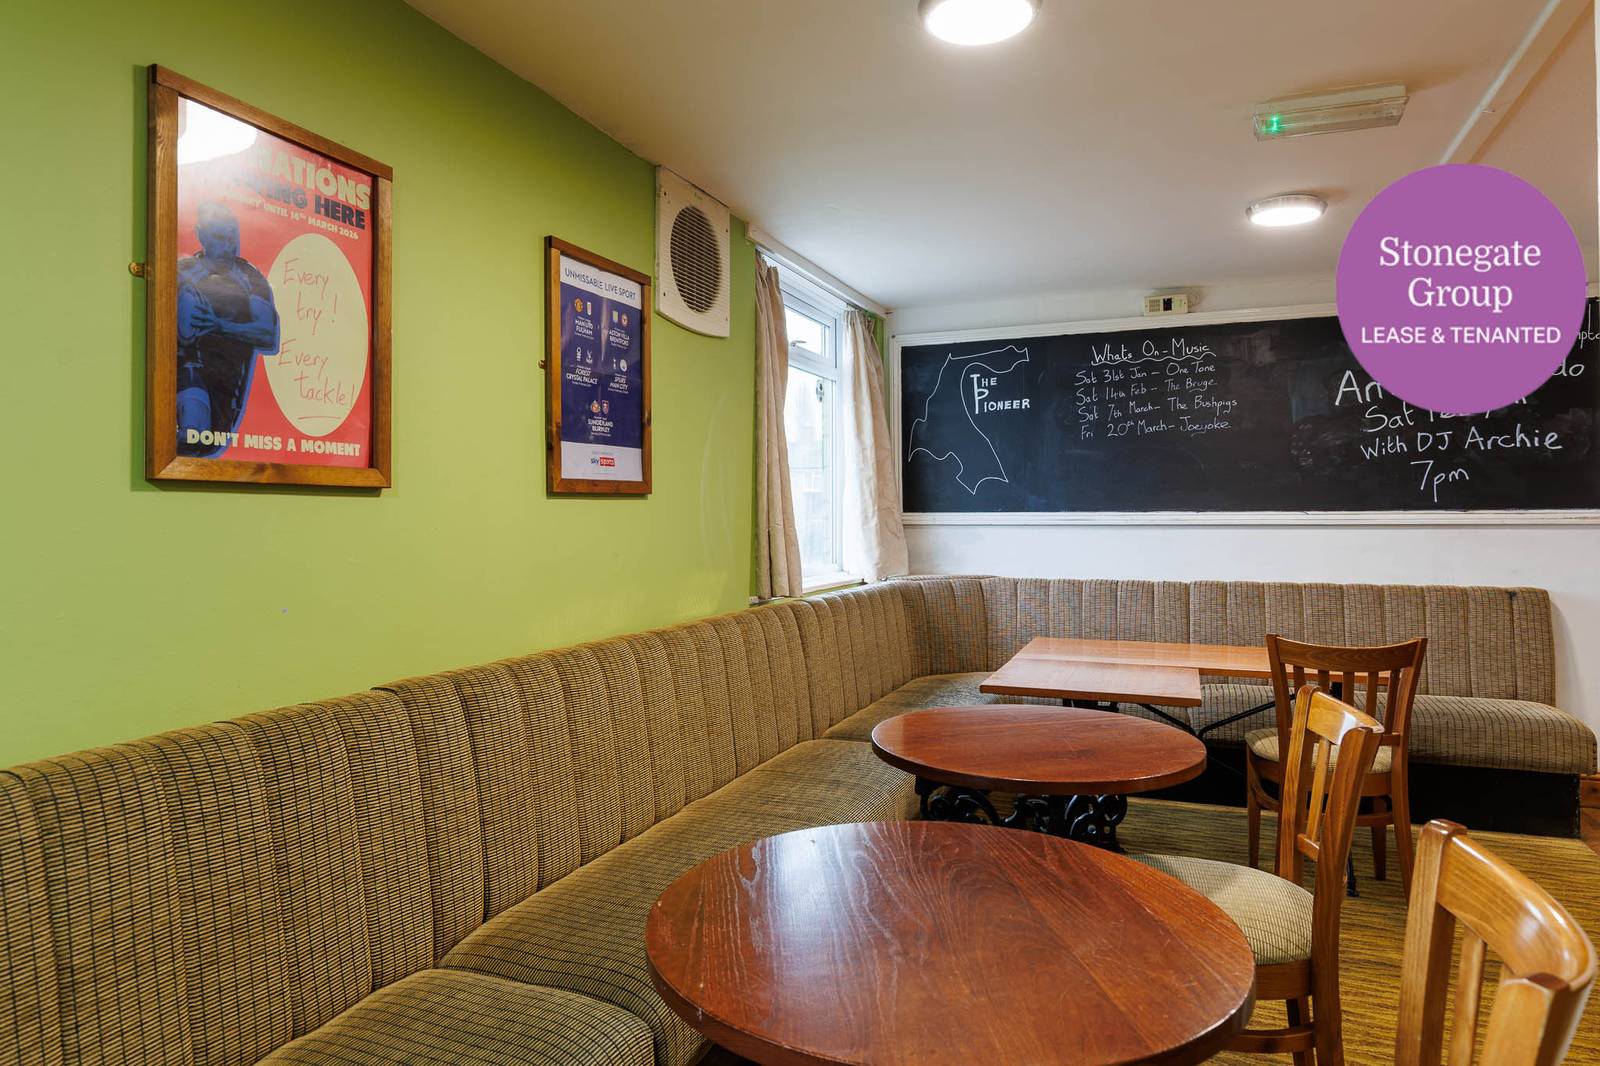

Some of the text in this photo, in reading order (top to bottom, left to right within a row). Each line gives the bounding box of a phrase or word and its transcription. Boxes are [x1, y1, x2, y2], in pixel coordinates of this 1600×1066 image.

[314, 195, 366, 230] HERE
[308, 217, 337, 233] MARCH
[339, 228, 359, 240] 2026
[283, 257, 331, 296] Every
[565, 268, 635, 299] UNMISSABLE LIVE SPORT
[278, 338, 329, 381] Every
[1092, 343, 1132, 363] Whats
[1075, 370, 1098, 386] Sat
[1103, 369, 1125, 384] 31st
[1130, 367, 1147, 379] Jan
[1166, 362, 1189, 376] One
[1191, 361, 1216, 373] Tone
[294, 371, 355, 409] tackle!
[973, 389, 1031, 415] PIONEER
[1076, 388, 1098, 406] Sat
[1131, 383, 1147, 396] Feb
[1164, 379, 1181, 392] The
[1078, 406, 1099, 423] Sat
[1107, 404, 1123, 421] 7th
[1167, 397, 1189, 412] The
[1194, 395, 1238, 416] Bushpigs
[1363, 401, 1415, 433] Sat
[186, 428, 361, 457] DON'T MISS A MOMENT
[1080, 425, 1094, 440] Fri
[1106, 420, 1135, 437] 20th
[1417, 431, 1453, 452] DJ
[1465, 424, 1563, 450] Archie
[1410, 460, 1469, 503] 7pm
